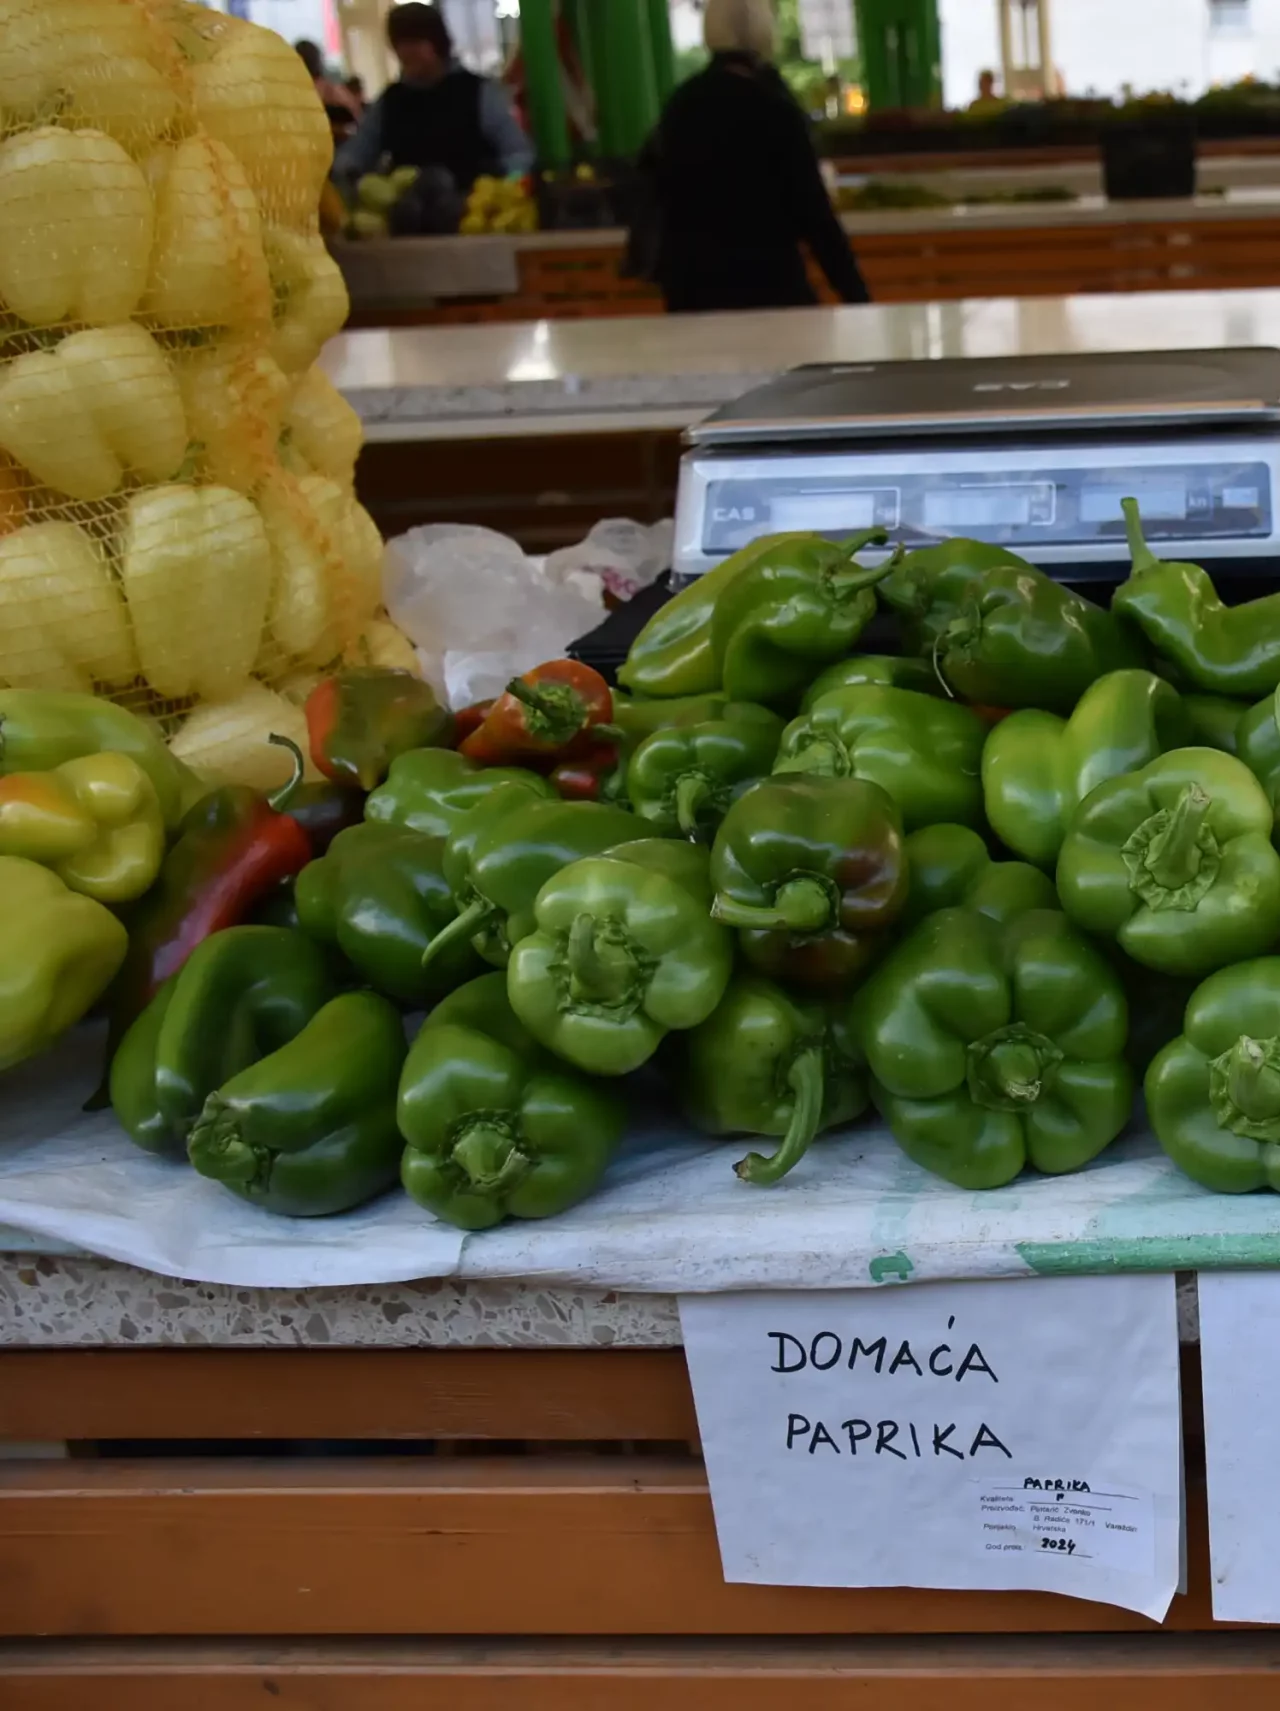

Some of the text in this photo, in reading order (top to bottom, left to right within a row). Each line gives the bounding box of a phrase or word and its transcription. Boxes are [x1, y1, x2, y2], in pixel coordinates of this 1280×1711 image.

[712, 507, 756, 521] CAS
[768, 1316, 998, 1382] DOMAĆA
[786, 1414, 1012, 1459] PAPRIKA
[1024, 1477, 1090, 1493] PAPRIKA
[1041, 1537, 1076, 1555] 2024
